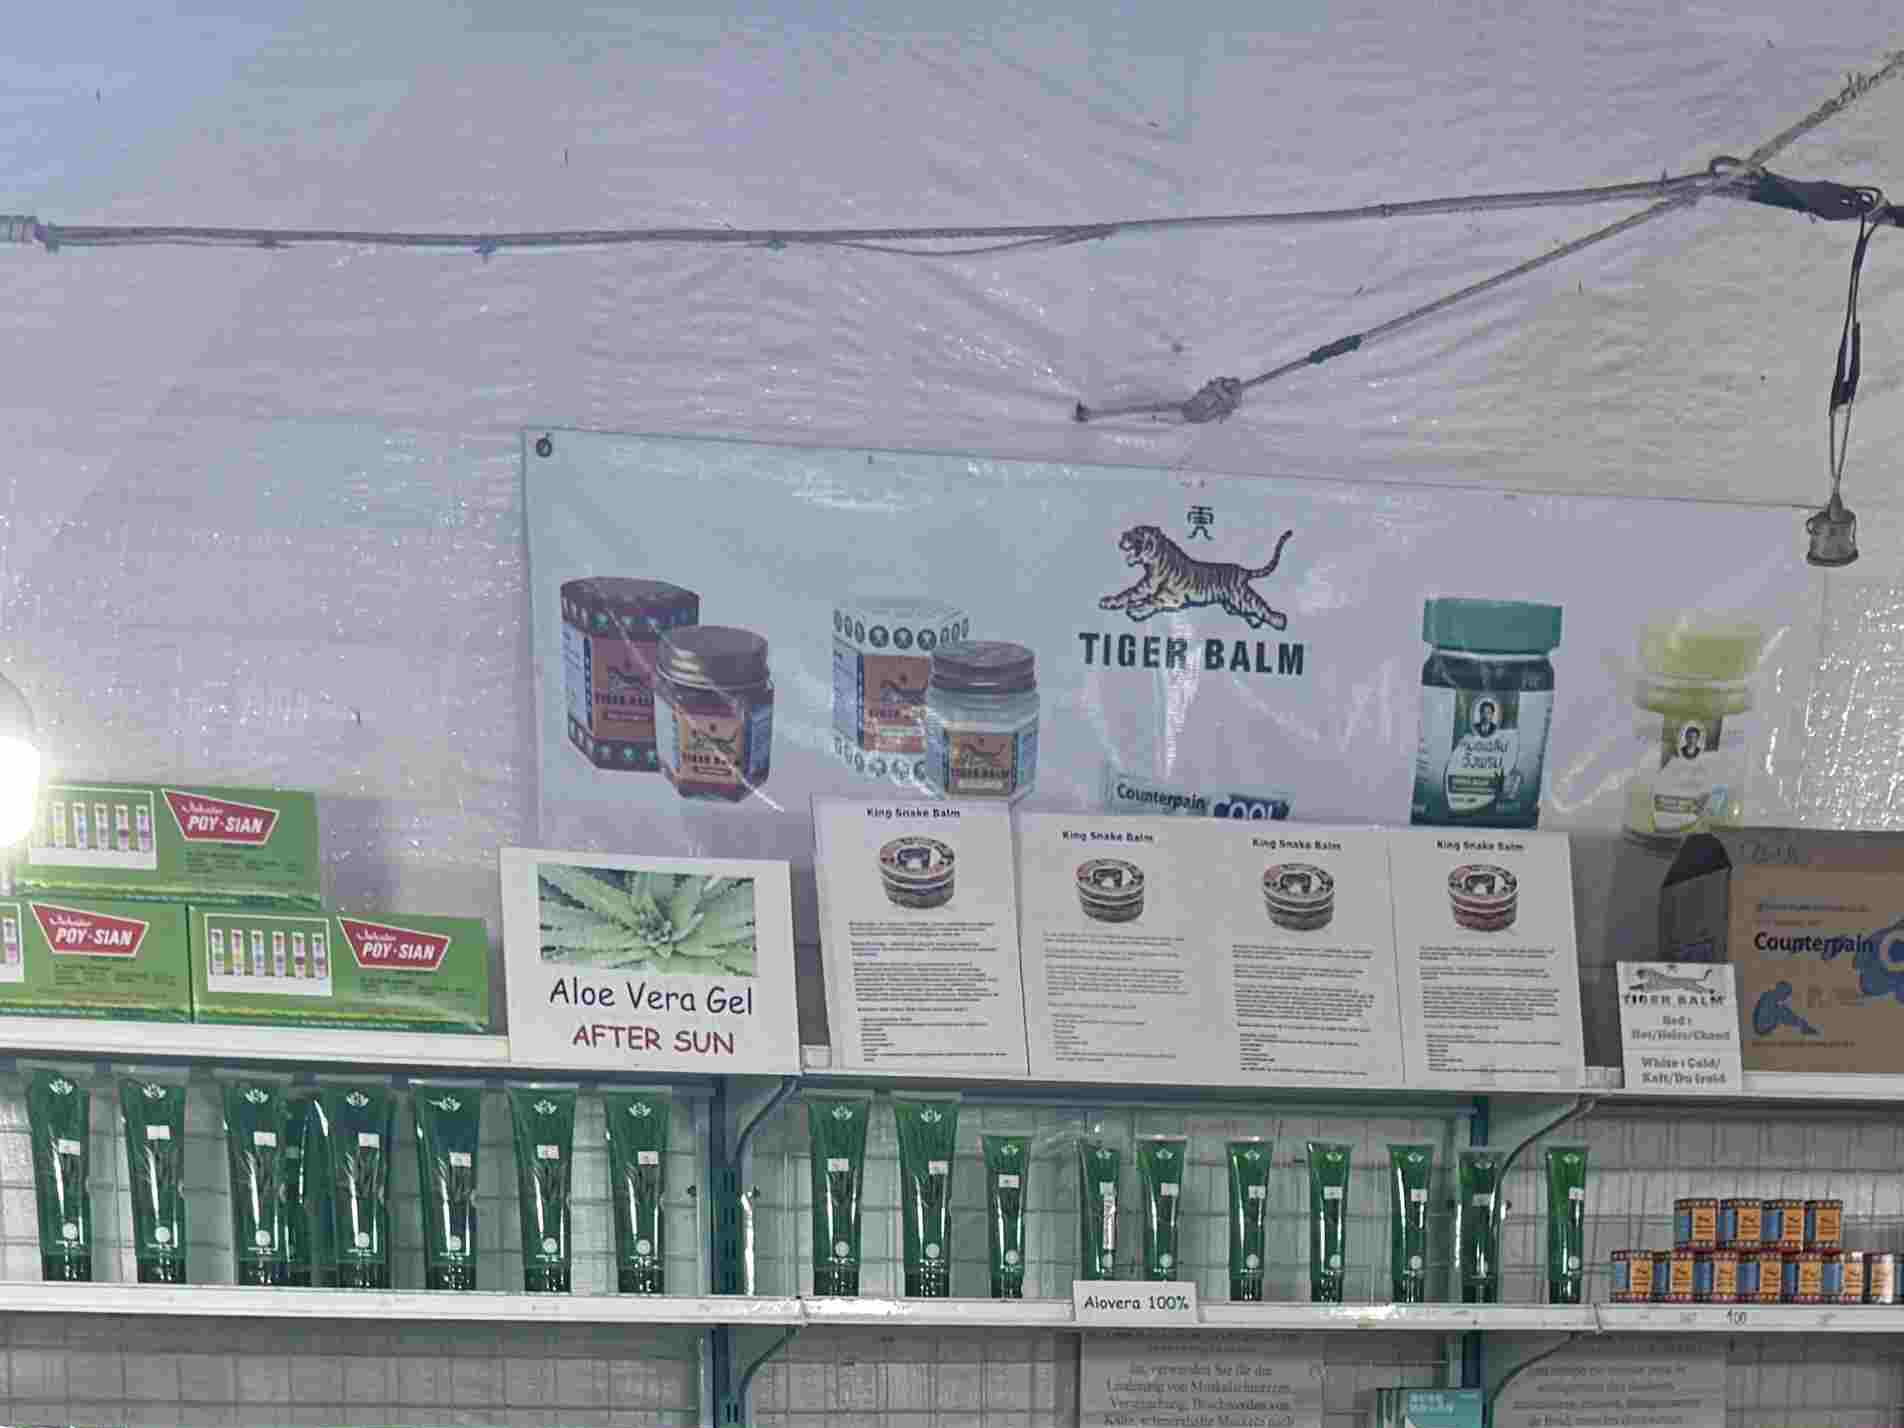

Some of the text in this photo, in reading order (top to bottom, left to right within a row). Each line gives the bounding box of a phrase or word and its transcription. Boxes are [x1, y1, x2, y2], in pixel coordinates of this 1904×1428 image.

[1079, 632, 1305, 676] TIGER BALM
[1116, 783, 1206, 810] Counterpain
[866, 806, 893, 820] King
[1062, 830, 1087, 843] King
[1754, 932, 1874, 960] Counterpain
[549, 976, 753, 1017] Aloe Vera Gel
[571, 1024, 735, 1055] AFTER SUN
[1083, 1294, 1190, 1311] Alovera 100%
